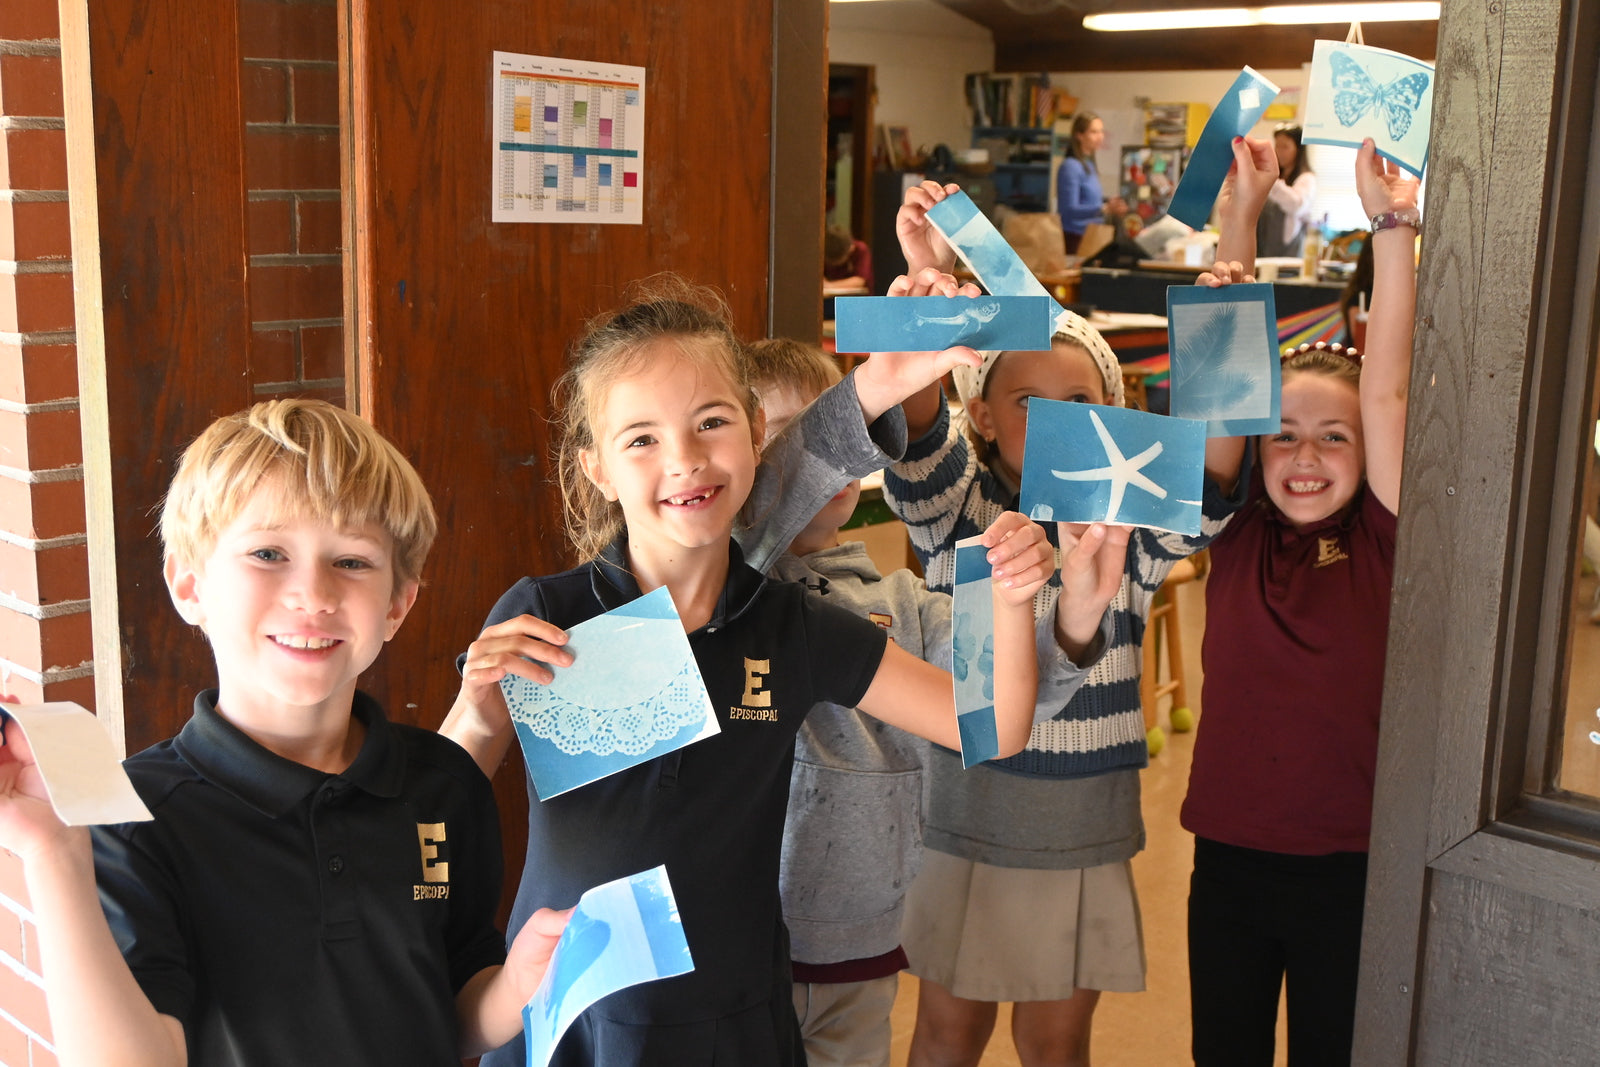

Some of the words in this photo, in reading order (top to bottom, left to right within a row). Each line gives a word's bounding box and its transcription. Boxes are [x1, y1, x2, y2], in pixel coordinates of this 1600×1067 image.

[1318, 537, 1340, 562] E
[741, 656, 772, 707] E
[729, 706, 779, 722] EPISCOPAL
[416, 822, 449, 883] E
